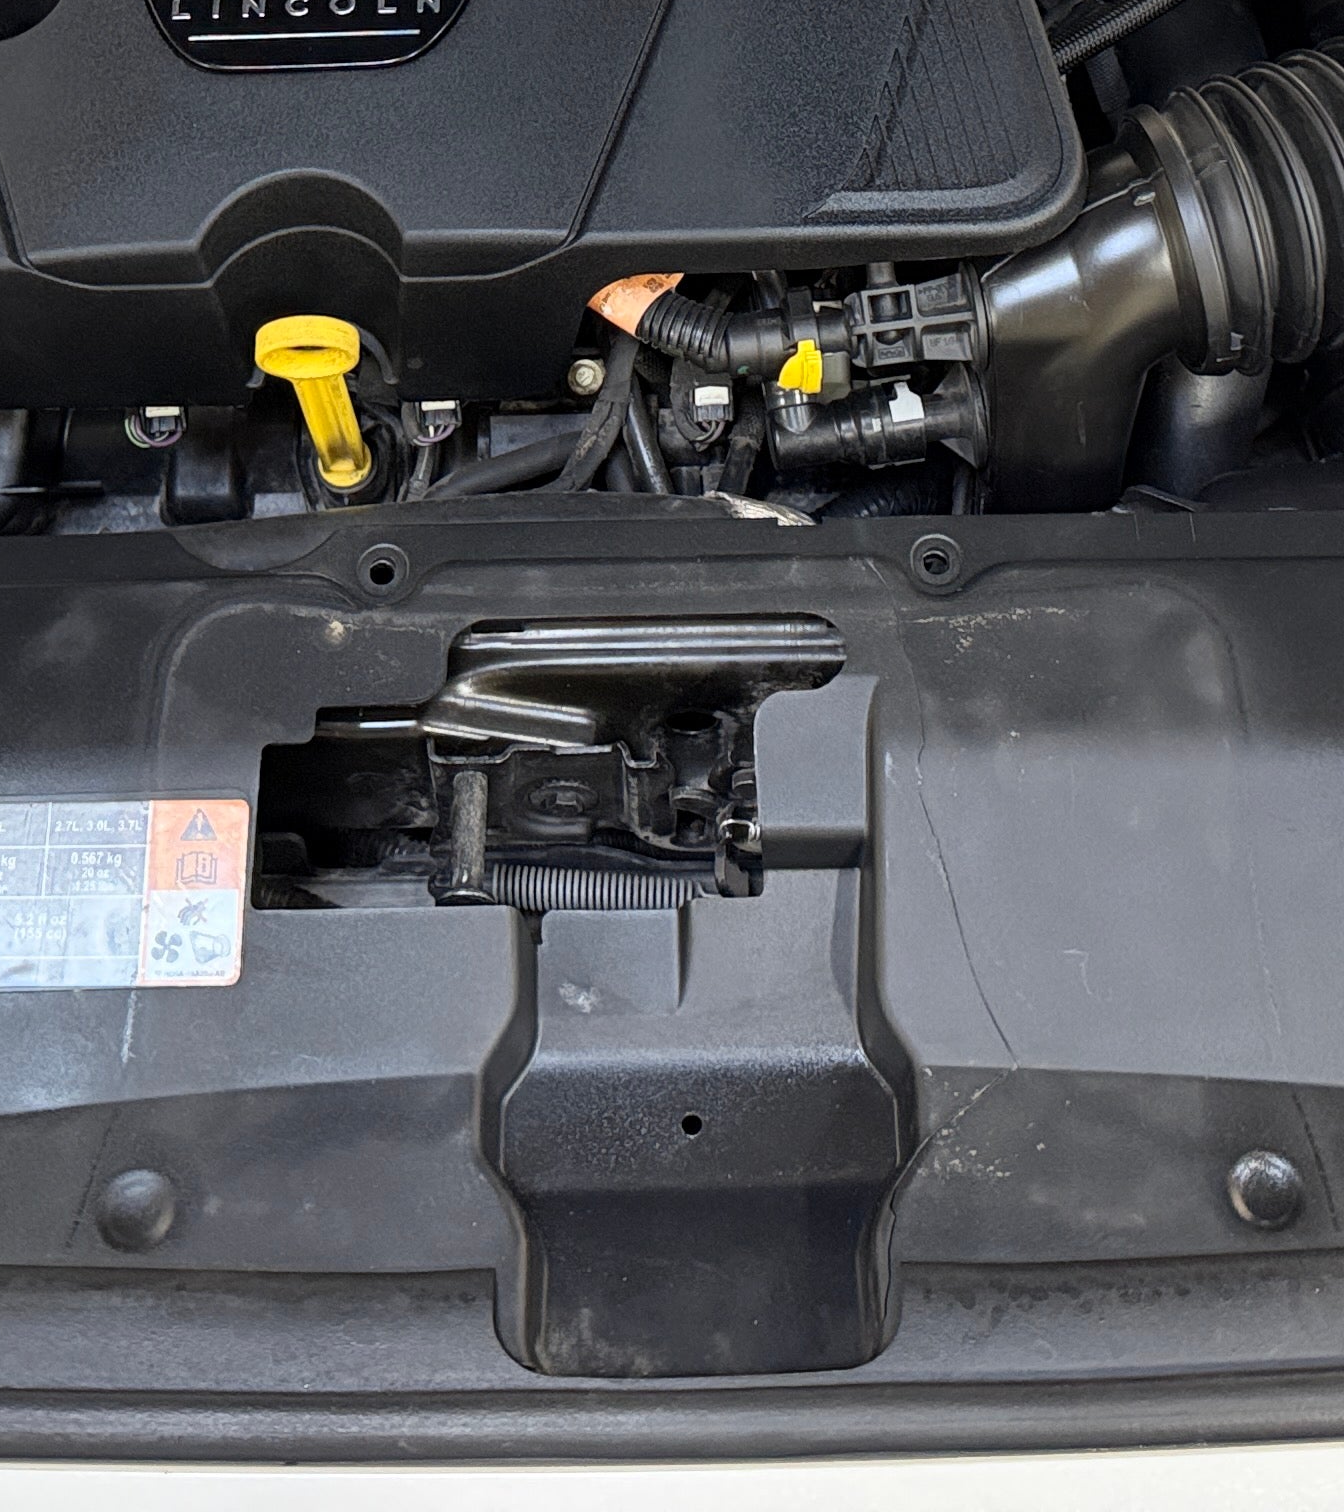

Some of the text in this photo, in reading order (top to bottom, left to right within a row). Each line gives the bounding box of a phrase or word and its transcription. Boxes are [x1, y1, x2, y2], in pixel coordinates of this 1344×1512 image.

[118, 819, 142, 832] 3.7L
[1, 854, 17, 870] kg
[71, 852, 122, 866] 0.567 kg
